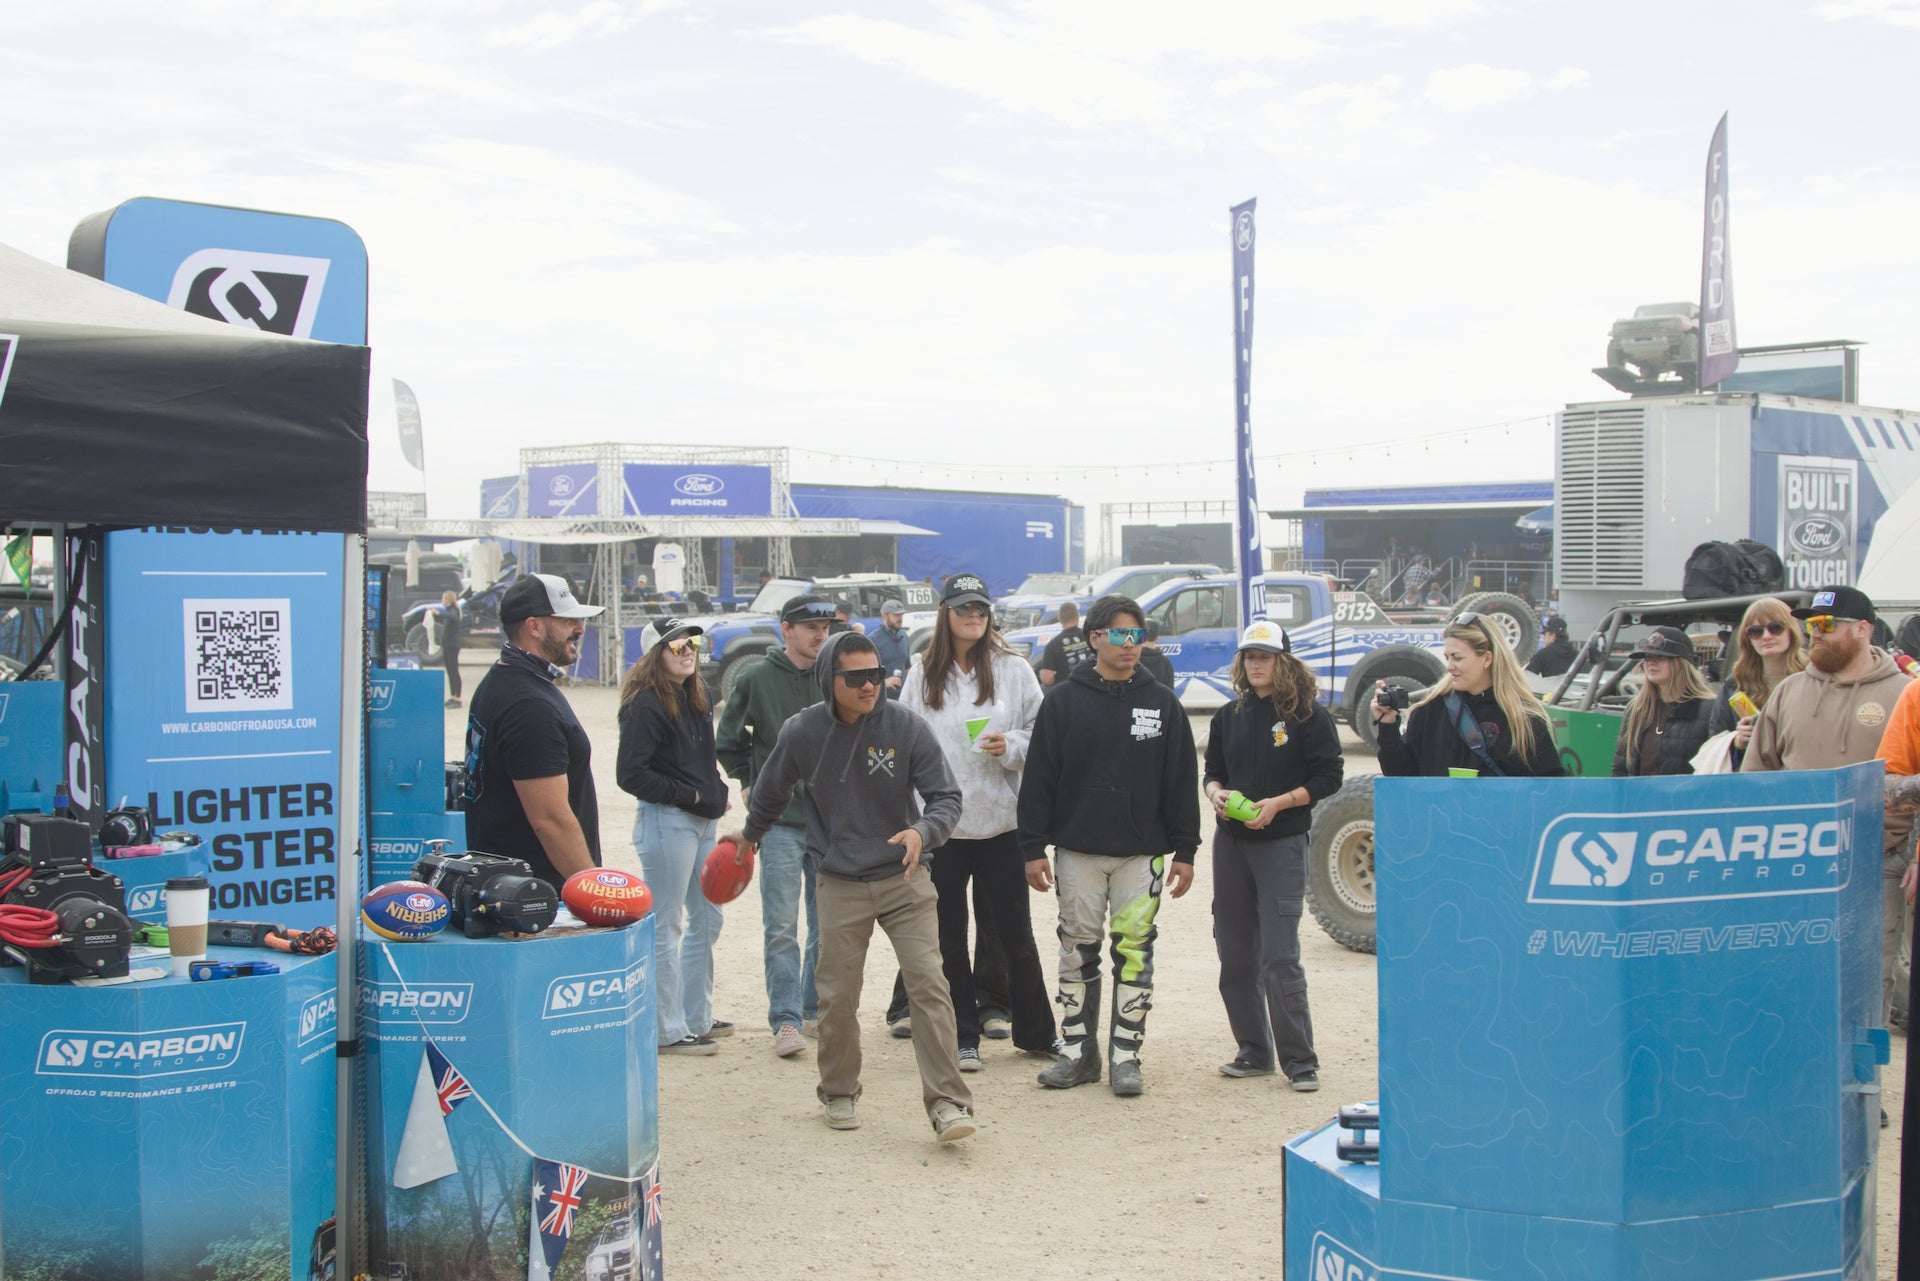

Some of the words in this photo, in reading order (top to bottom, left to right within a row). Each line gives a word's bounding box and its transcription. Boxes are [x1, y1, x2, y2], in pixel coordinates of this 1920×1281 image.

[683, 476, 715, 493] Ford
[1787, 470, 1850, 511] BUILT
[1801, 522, 1833, 546] Ford
[1787, 558, 1848, 590] TOUGH
[908, 589, 931, 602] 766
[1334, 602, 1376, 622] 8135
[161, 718, 317, 734] WWW.CARBONOFFROADUSA.COM
[147, 783, 333, 827] LIGHTER
[207, 827, 335, 873] STER
[1646, 817, 1851, 865] CARBON
[577, 880, 645, 899] SHERRIN
[593, 875, 625, 885] AFL
[385, 901, 448, 924] SHERRIN
[410, 898, 432, 908] AFL
[587, 964, 646, 997] CARBON
[551, 1025, 591, 1036] OFFROAD
[92, 1032, 236, 1060] CARBON
[45, 1088, 96, 1097] OFFROAD
[99, 1087, 182, 1099] PERFORMANCE
[185, 1080, 237, 1093] EXPERTS
